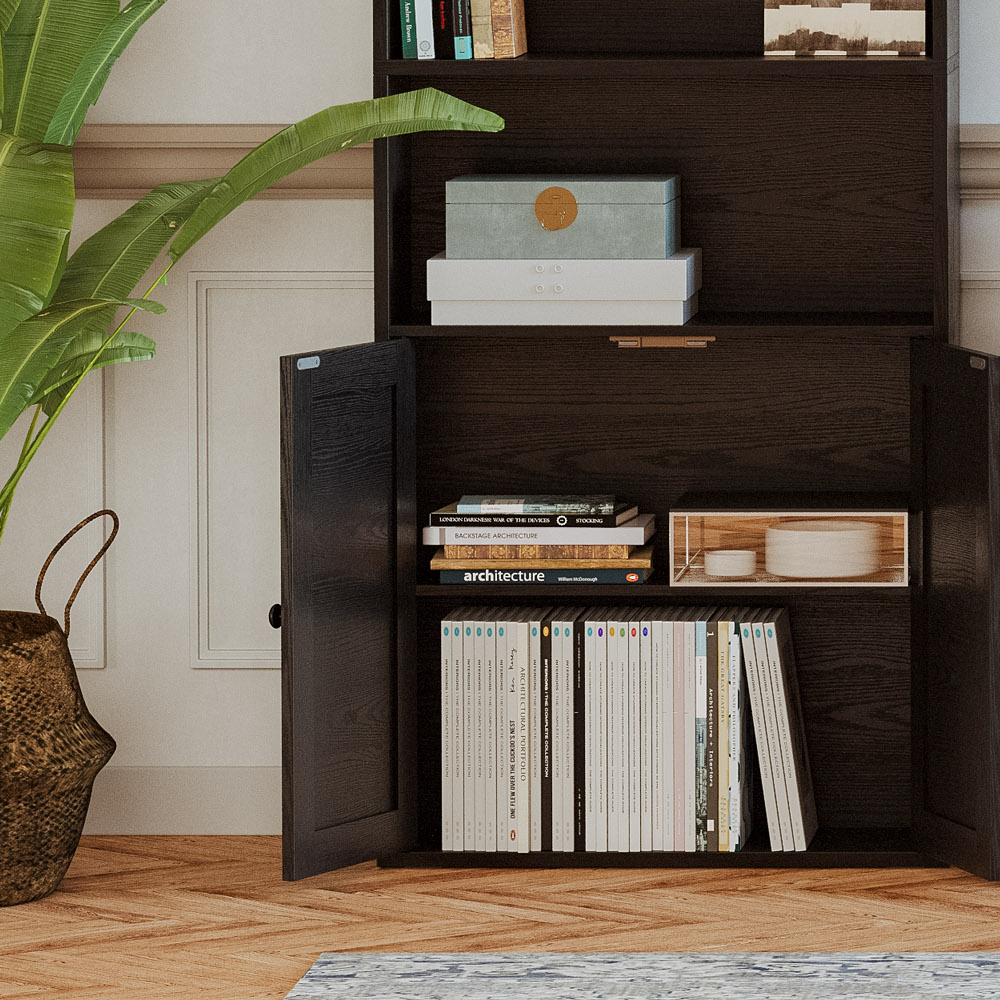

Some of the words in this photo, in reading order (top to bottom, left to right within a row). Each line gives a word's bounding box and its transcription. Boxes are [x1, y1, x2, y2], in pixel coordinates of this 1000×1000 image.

[404, 1, 412, 23] Andrew
[405, 24, 413, 43] Brown
[463, 569, 545, 582] architecture
